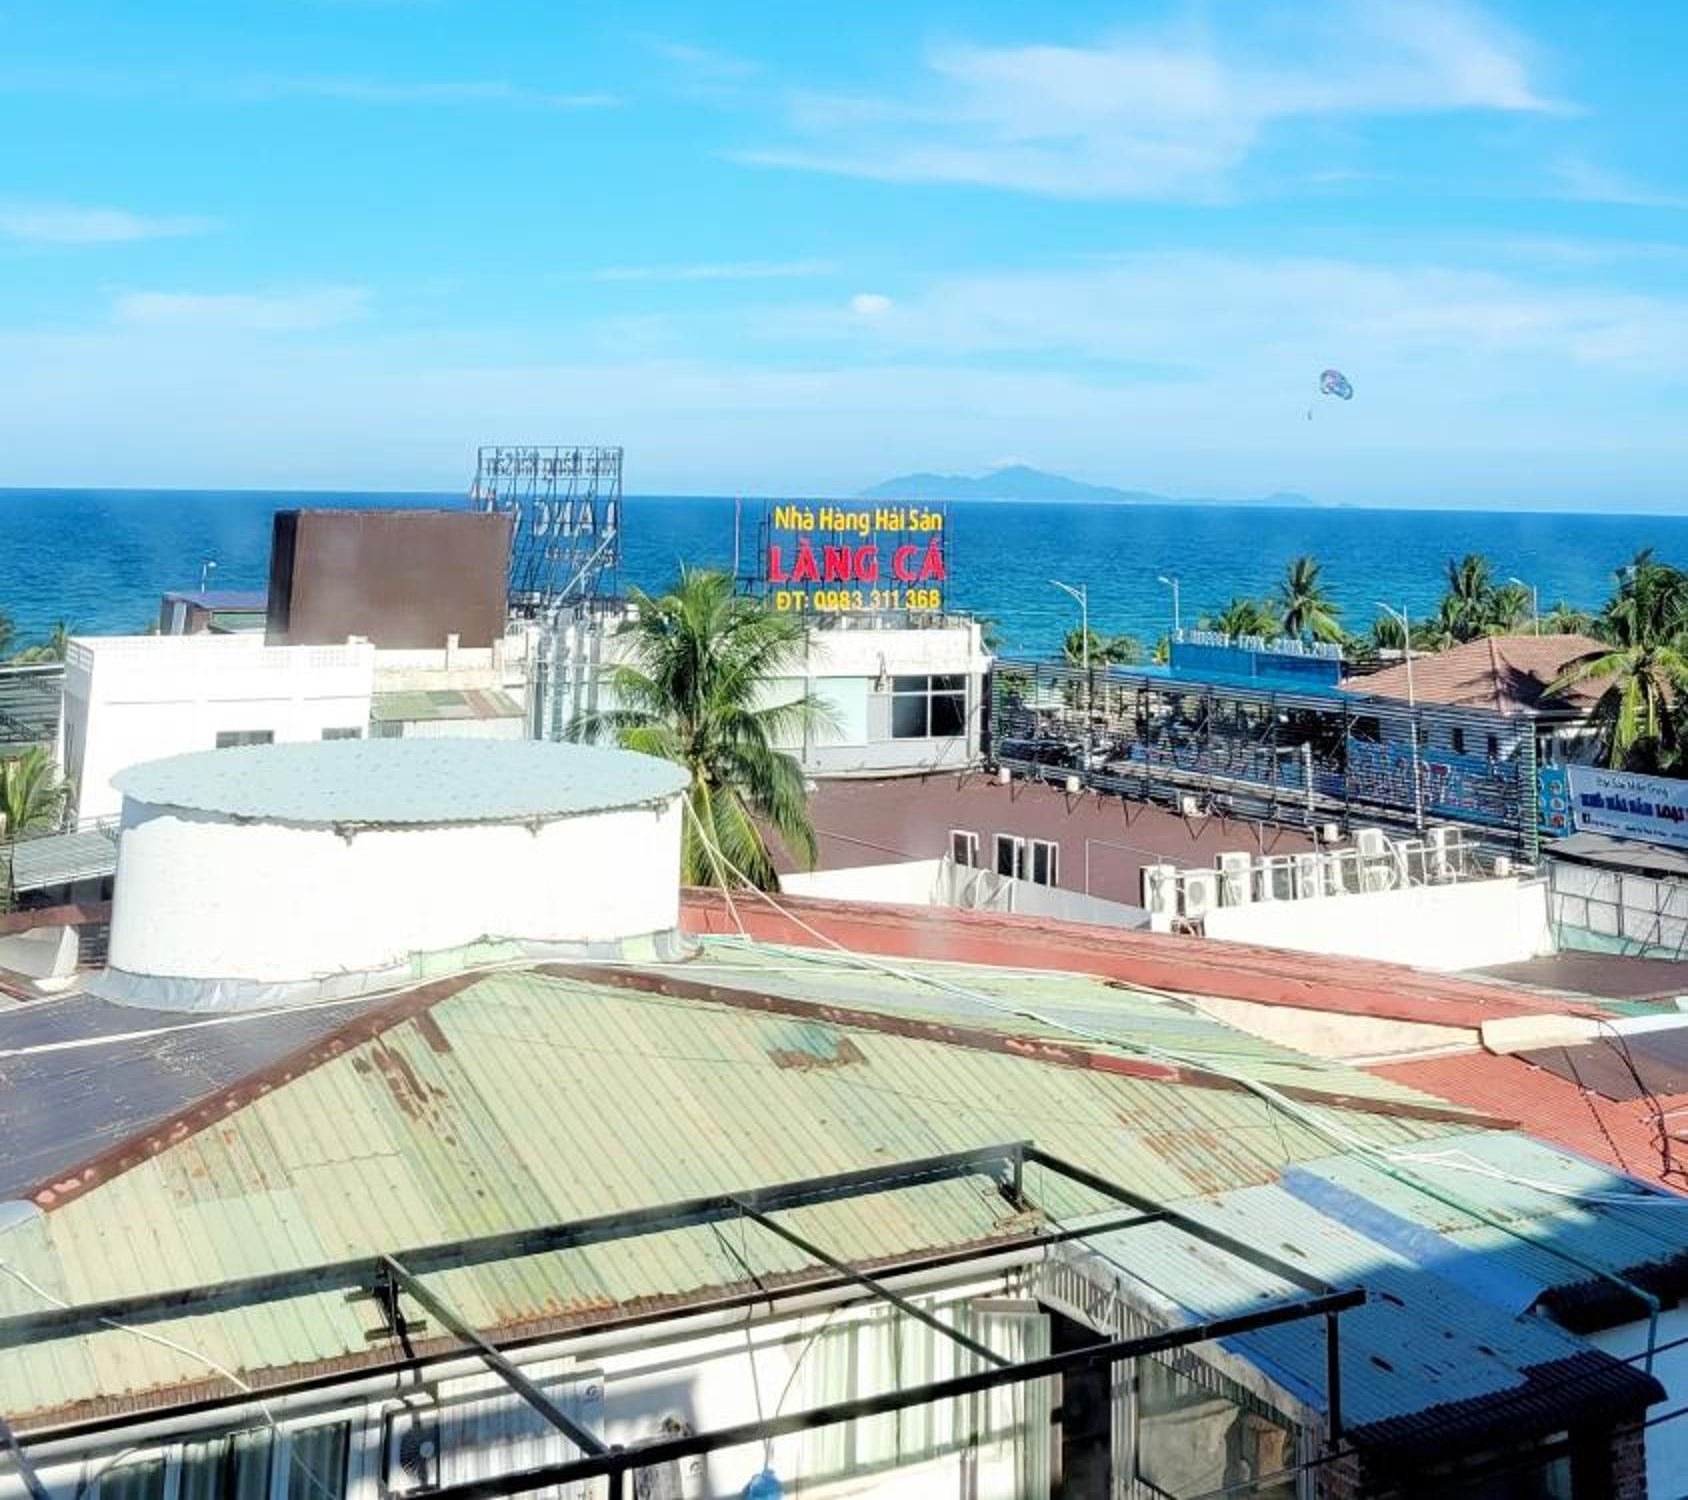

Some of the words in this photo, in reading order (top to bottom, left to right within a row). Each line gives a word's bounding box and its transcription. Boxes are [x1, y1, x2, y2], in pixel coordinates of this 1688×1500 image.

[775, 504, 814, 531] Nhà
[819, 506, 870, 536] Hàng
[875, 506, 905, 531] Hải
[909, 506, 943, 531] Sản
[768, 538, 879, 582] LÀNG
[870, 588, 899, 610] 311
